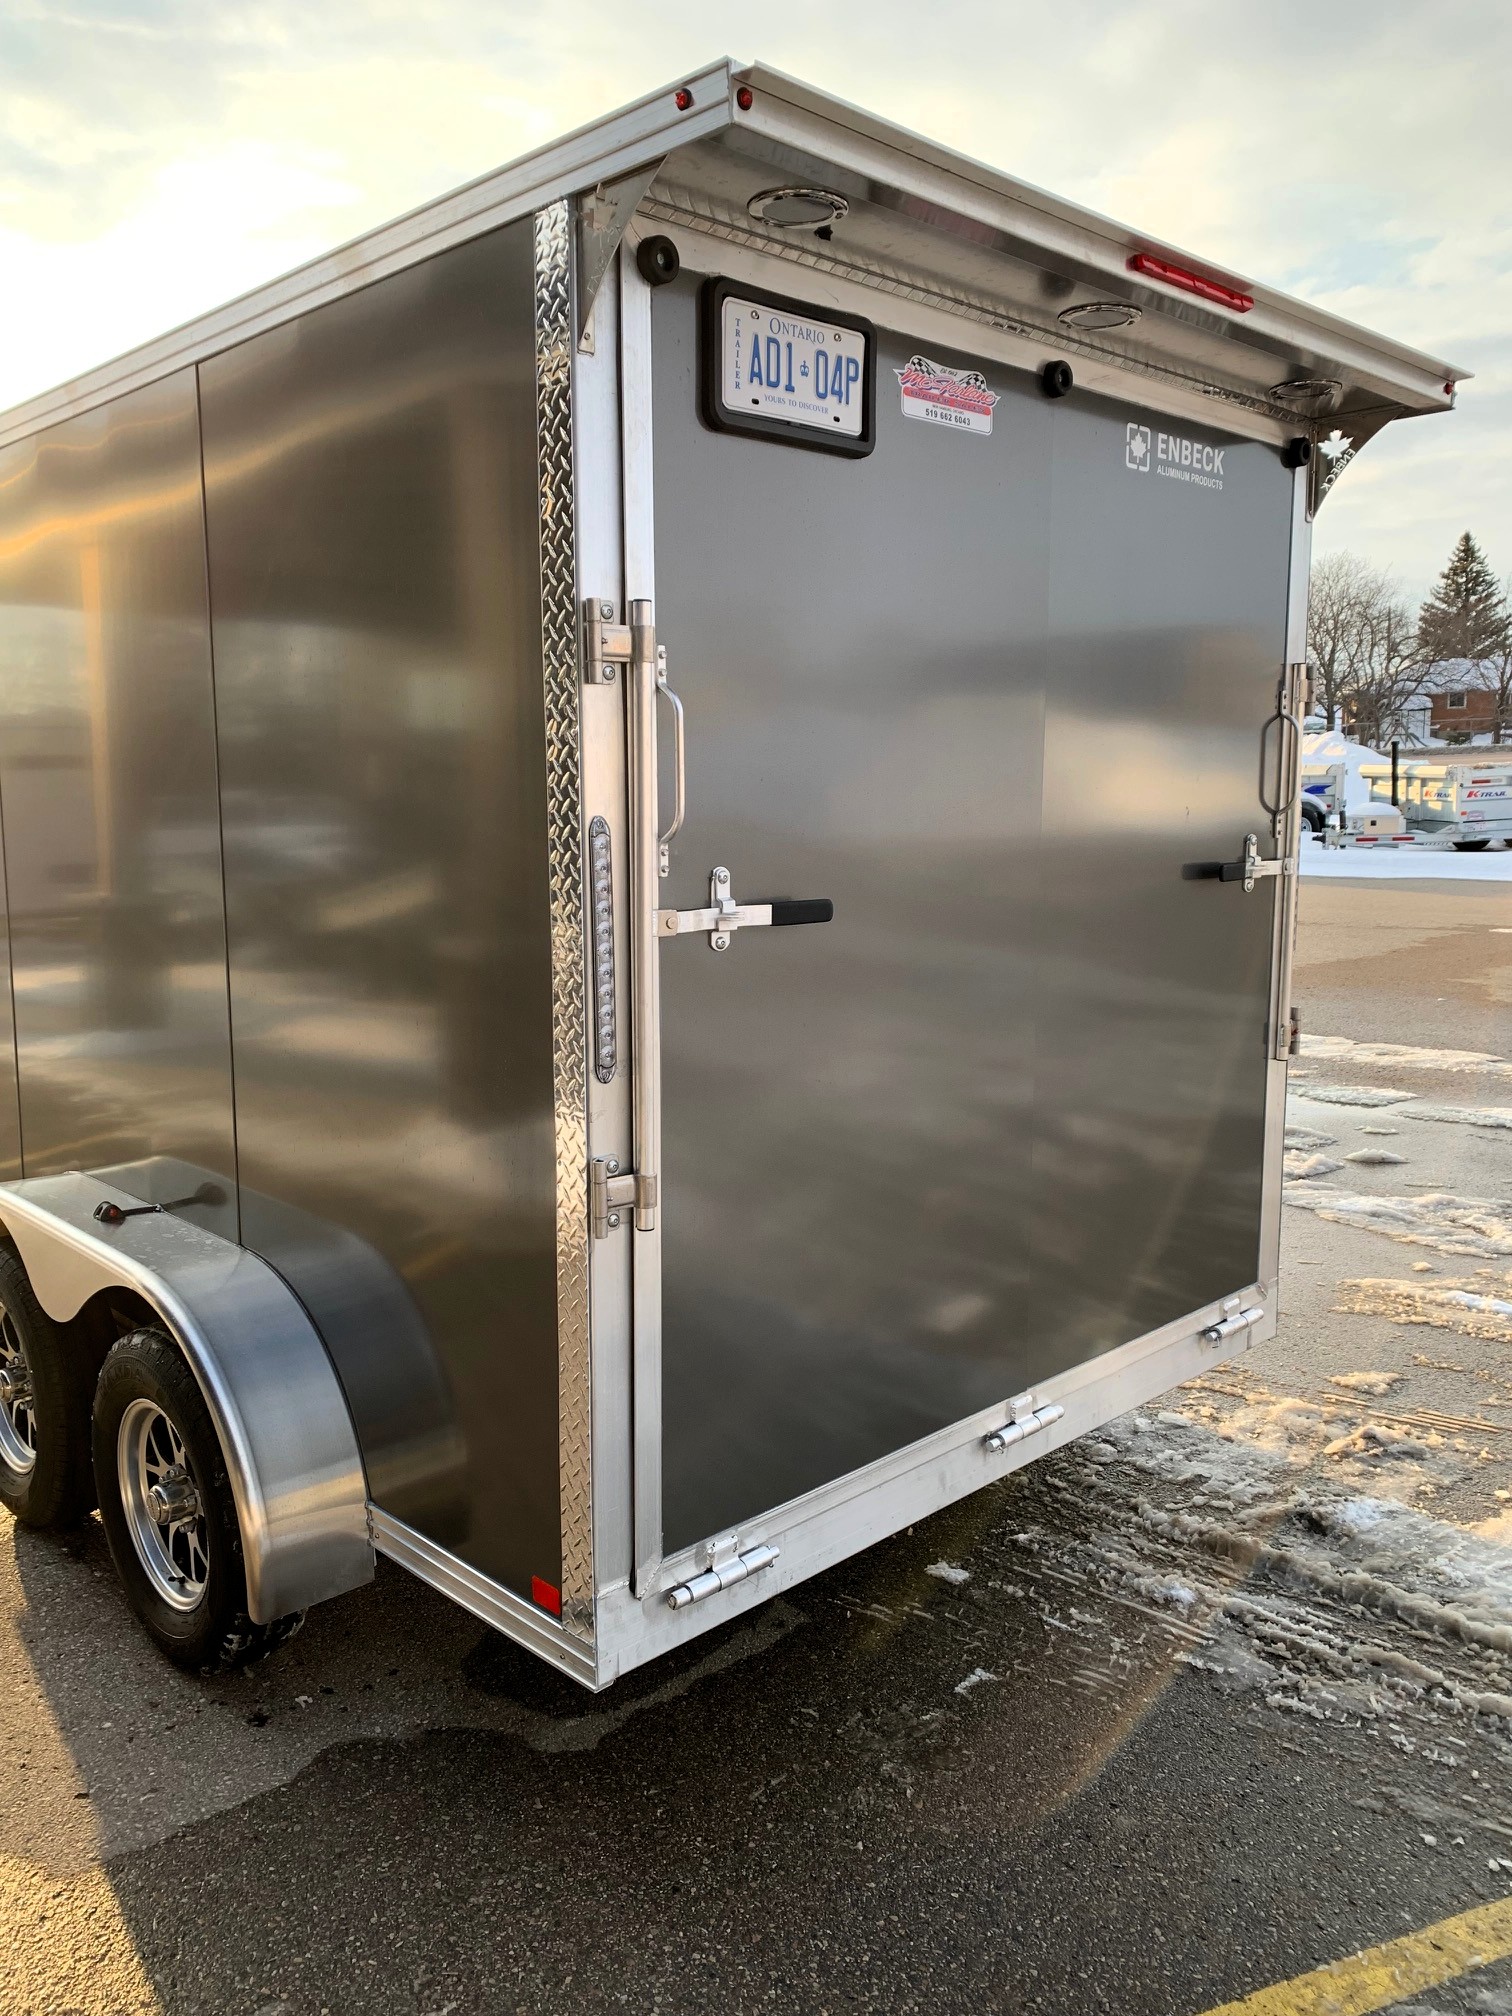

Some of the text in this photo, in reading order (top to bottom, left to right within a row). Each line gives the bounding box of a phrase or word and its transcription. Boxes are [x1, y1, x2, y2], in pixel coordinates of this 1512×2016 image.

[769, 316, 825, 345] ONTARIO
[749, 333, 860, 406] AD1 04P
[764, 393, 829, 415] YOURS TO DISCOVER
[925, 408, 938, 418] 519
[940, 411, 953, 422] 662
[954, 414, 971, 426] 6043
[1157, 432, 1226, 475] ENBECK
[1157, 464, 1224, 490] ALUMINUM PRODUCTS
